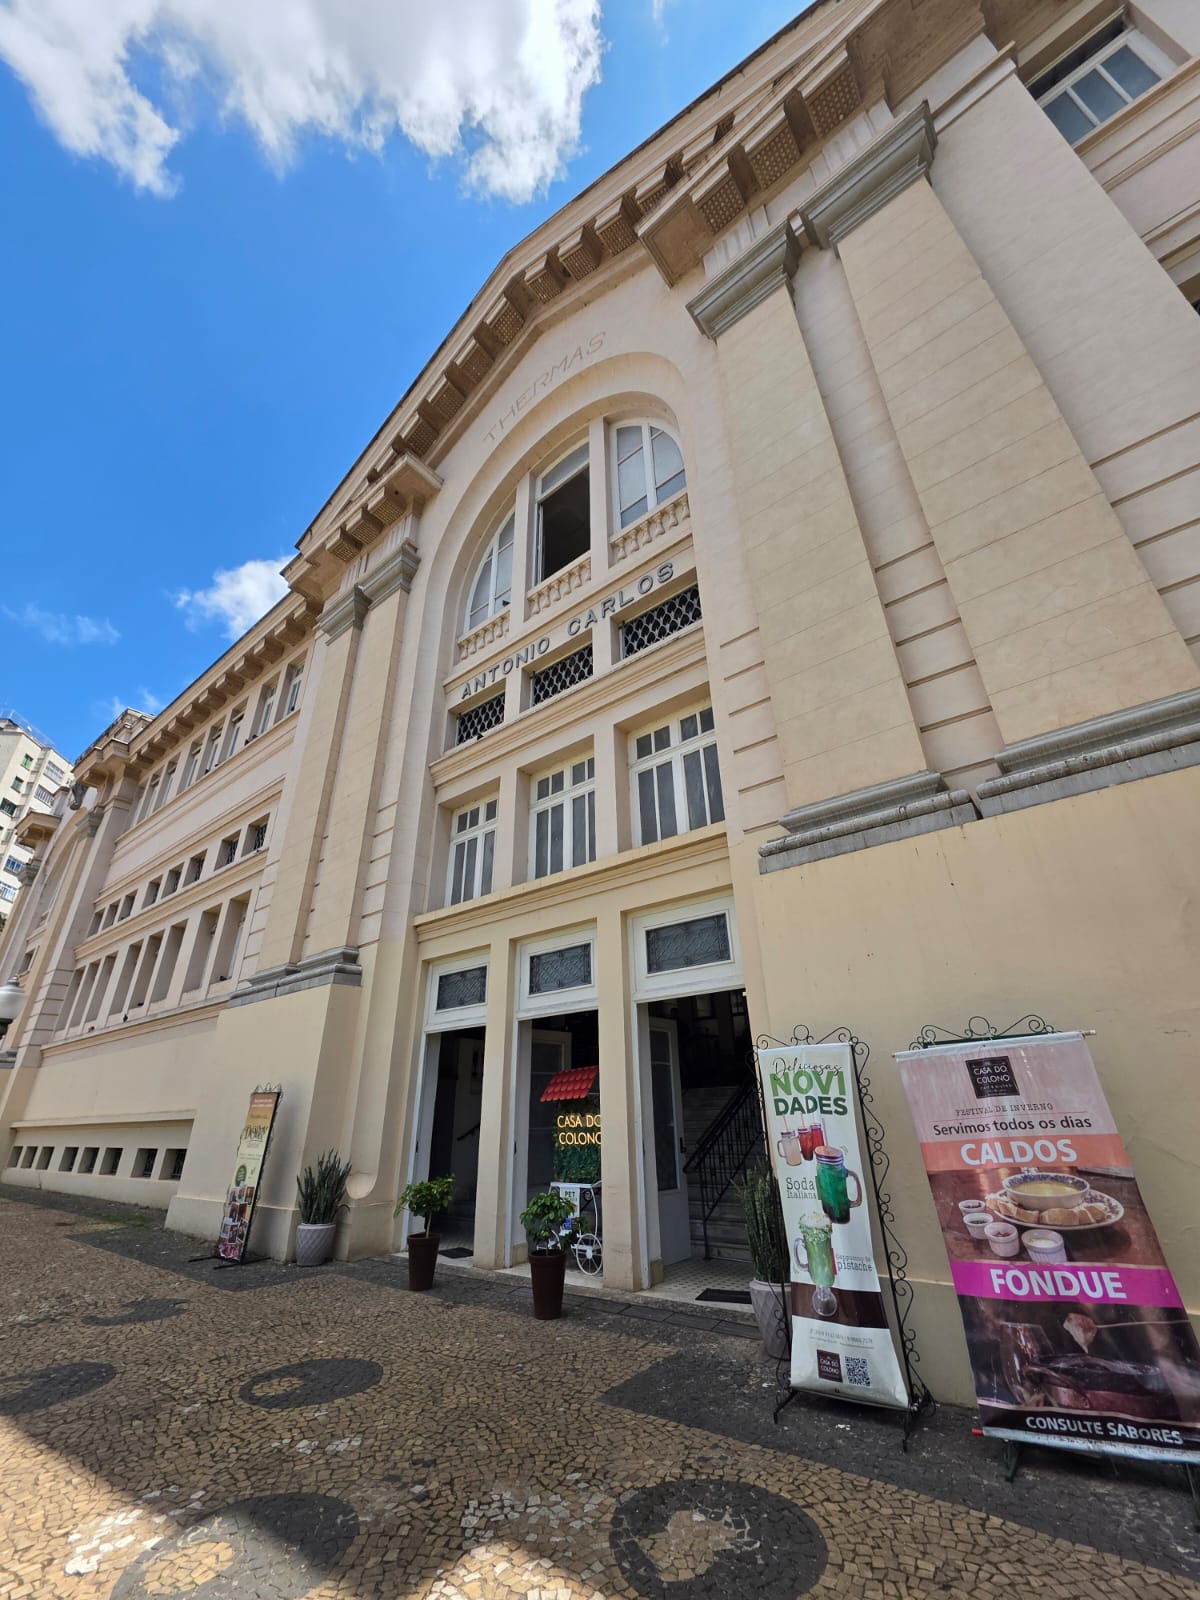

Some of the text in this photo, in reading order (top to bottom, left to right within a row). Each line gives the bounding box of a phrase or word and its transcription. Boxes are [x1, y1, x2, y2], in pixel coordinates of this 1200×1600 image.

[482, 331, 606, 441] THERMAS
[461, 562, 674, 700] ANTONIO CARLOS
[973, 1065, 1007, 1075] CASA DO
[976, 1074, 1010, 1084] COLONO
[769, 1070, 846, 1097] NOVI
[774, 1096, 848, 1116] DADES
[955, 1102, 1054, 1117] FESTIVAL DE INVERNO
[557, 1114, 583, 1128] CASA
[933, 1116, 1092, 1136] Servimos todos os dias
[960, 1139, 1078, 1166] CALDOS
[785, 1176, 815, 1191] Soda
[989, 1268, 1128, 1299] FONDUE
[1025, 1416, 1184, 1445] CONSULTE SABORES
